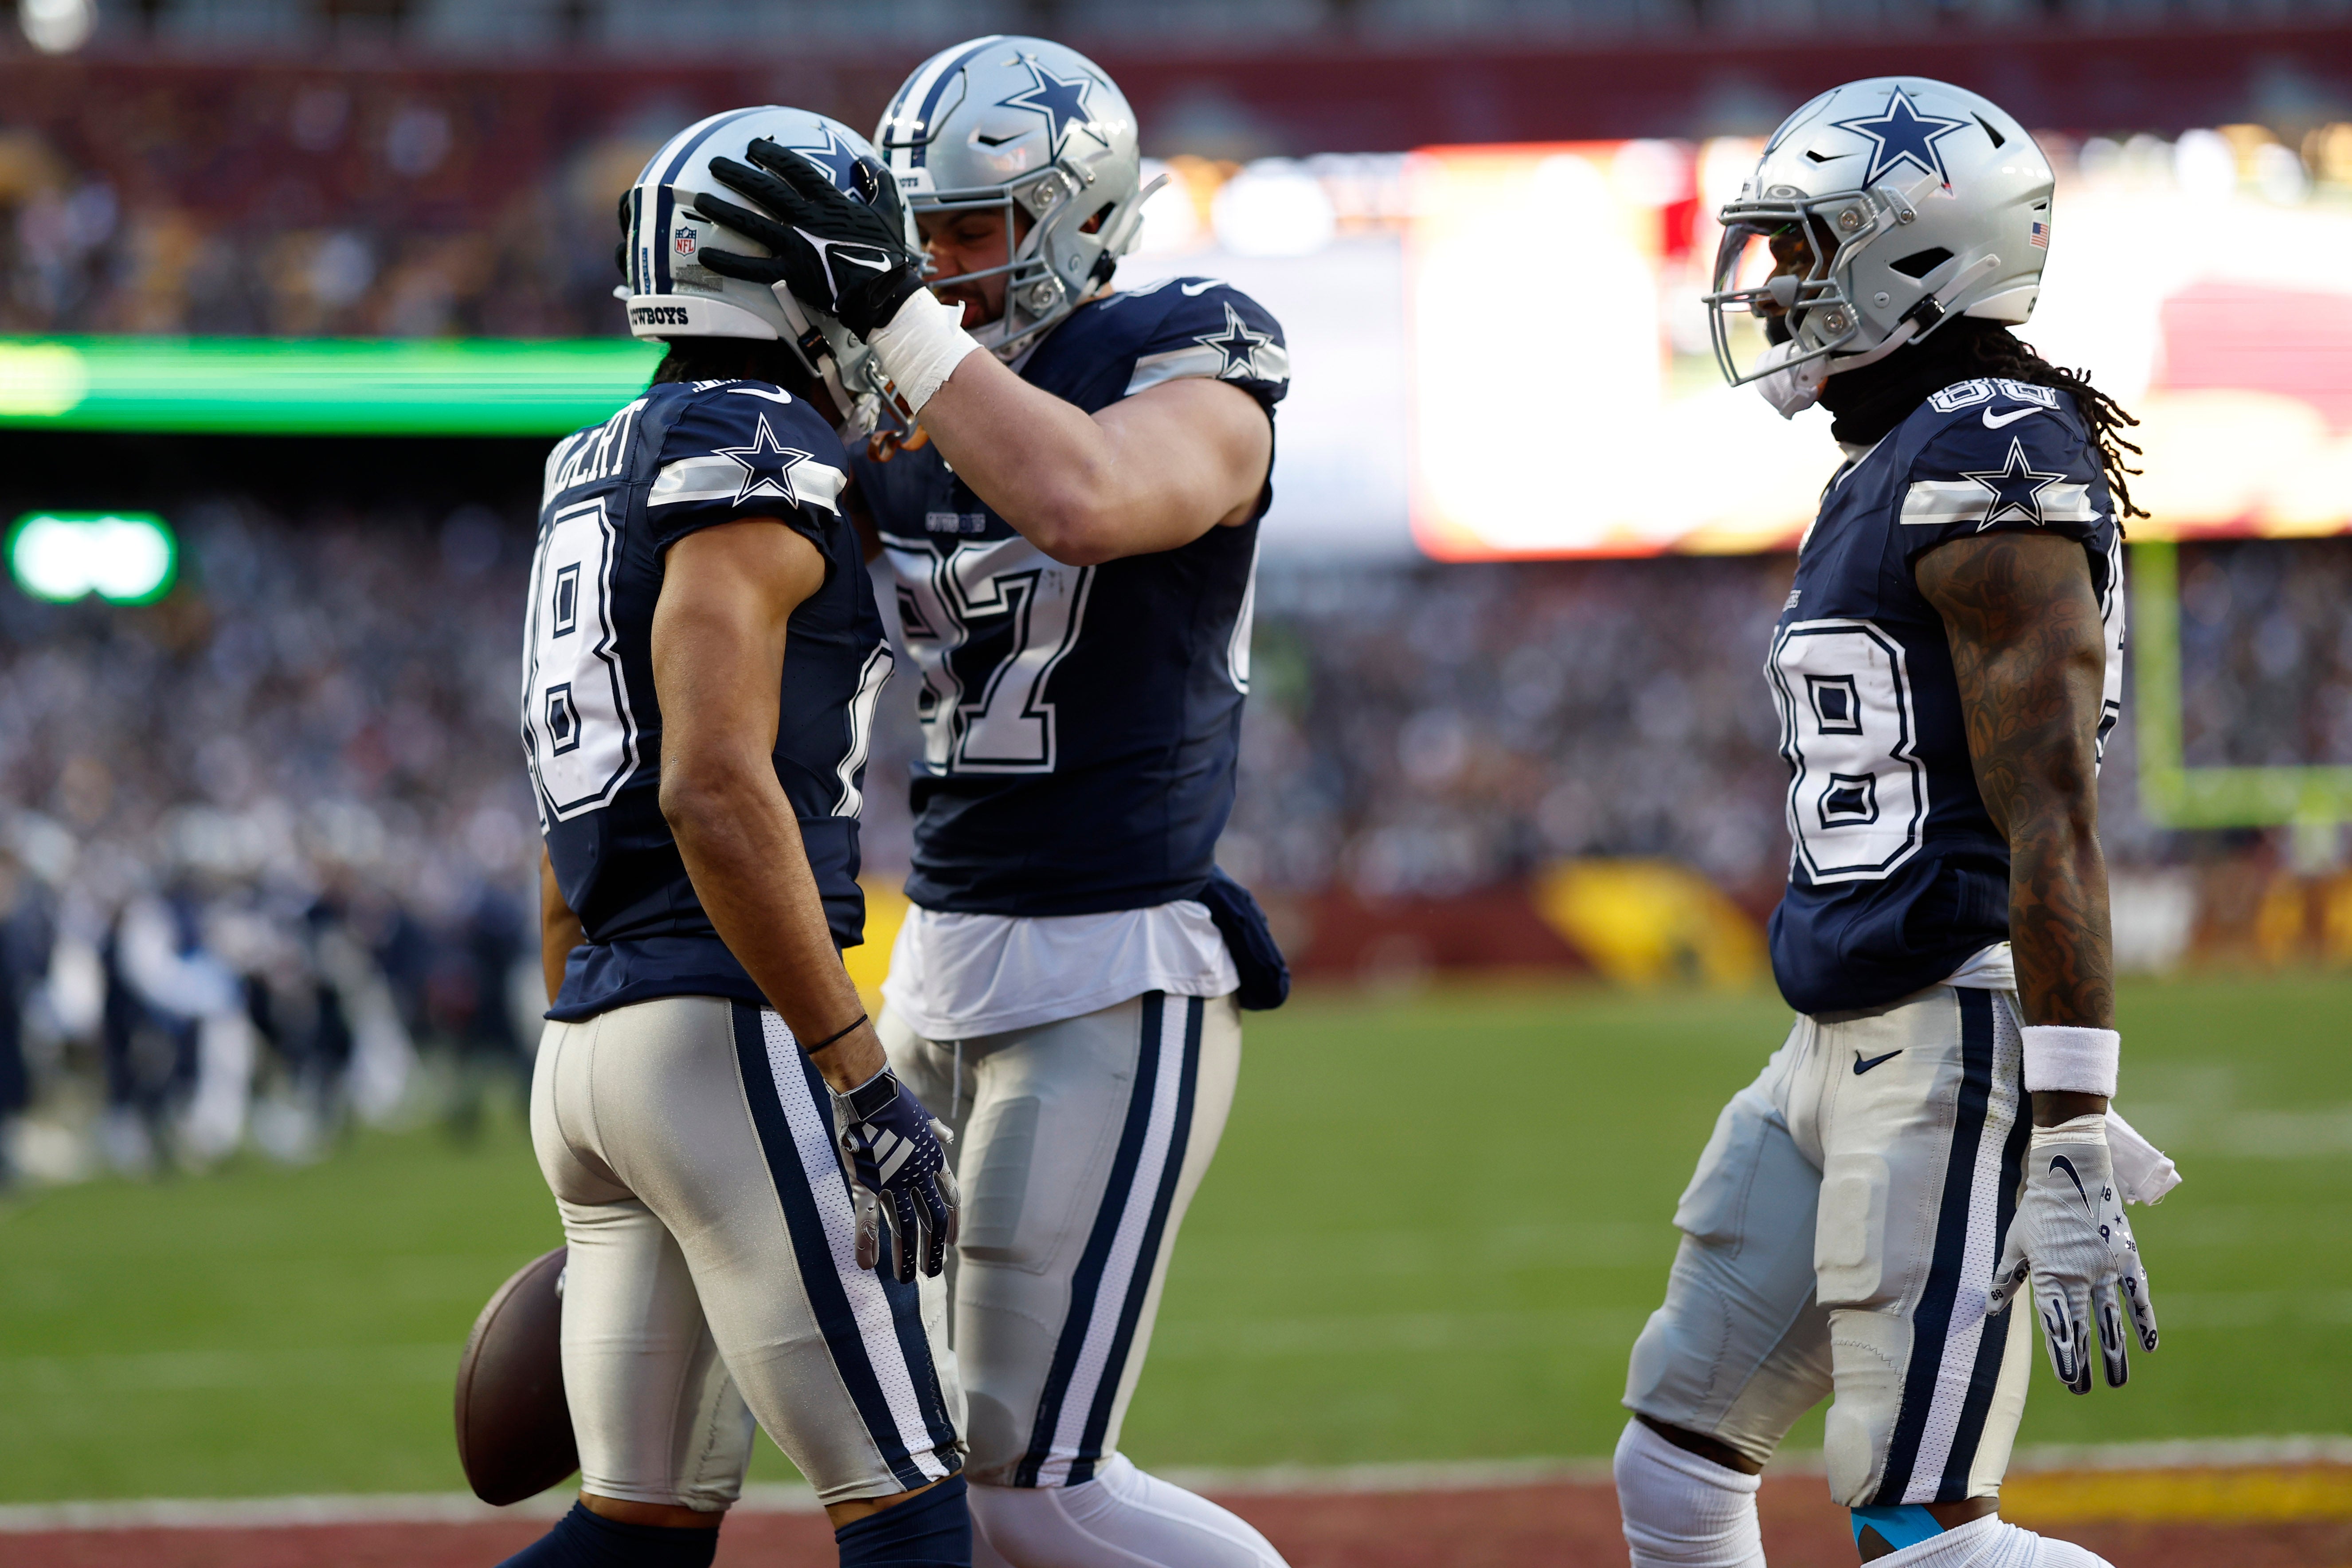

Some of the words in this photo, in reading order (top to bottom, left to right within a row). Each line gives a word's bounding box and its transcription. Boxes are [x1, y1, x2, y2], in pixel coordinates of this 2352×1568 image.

[677, 239, 694, 253] NFL
[878, 531, 1096, 776] 87
[1763, 618, 1930, 886] 8
[1991, 1289, 2004, 1301] 88
